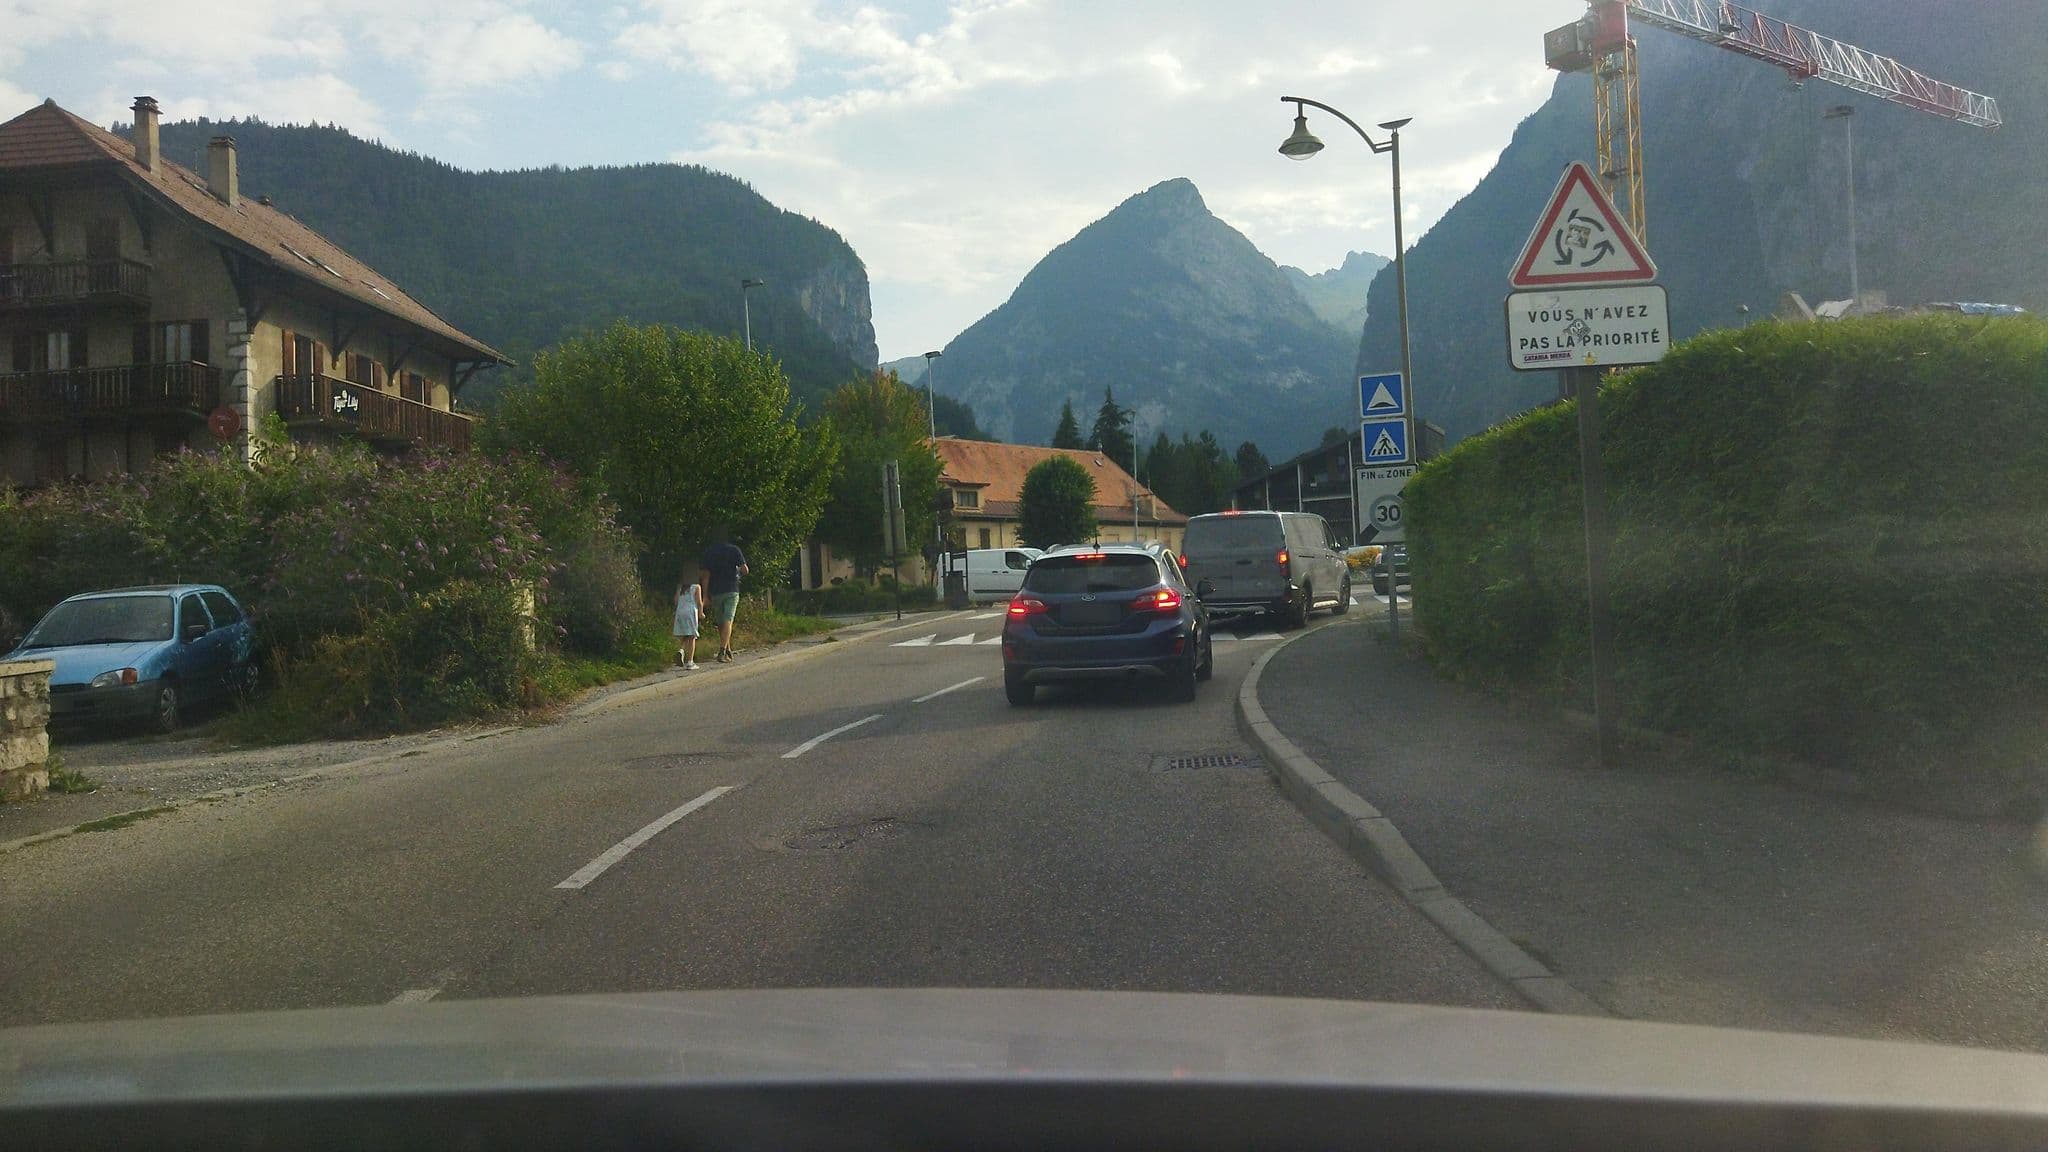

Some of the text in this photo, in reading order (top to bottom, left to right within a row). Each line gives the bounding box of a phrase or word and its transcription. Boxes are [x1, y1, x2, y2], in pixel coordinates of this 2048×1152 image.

[1528, 309, 1575, 323] VOUS
[1520, 336, 1550, 350] PAS
[1556, 335, 1576, 348] LA
[1582, 328, 1660, 347] PRIORITÉ
[1361, 471, 1376, 480] FIN
[1386, 468, 1412, 479] ZONE
[1377, 504, 1401, 522] 30
